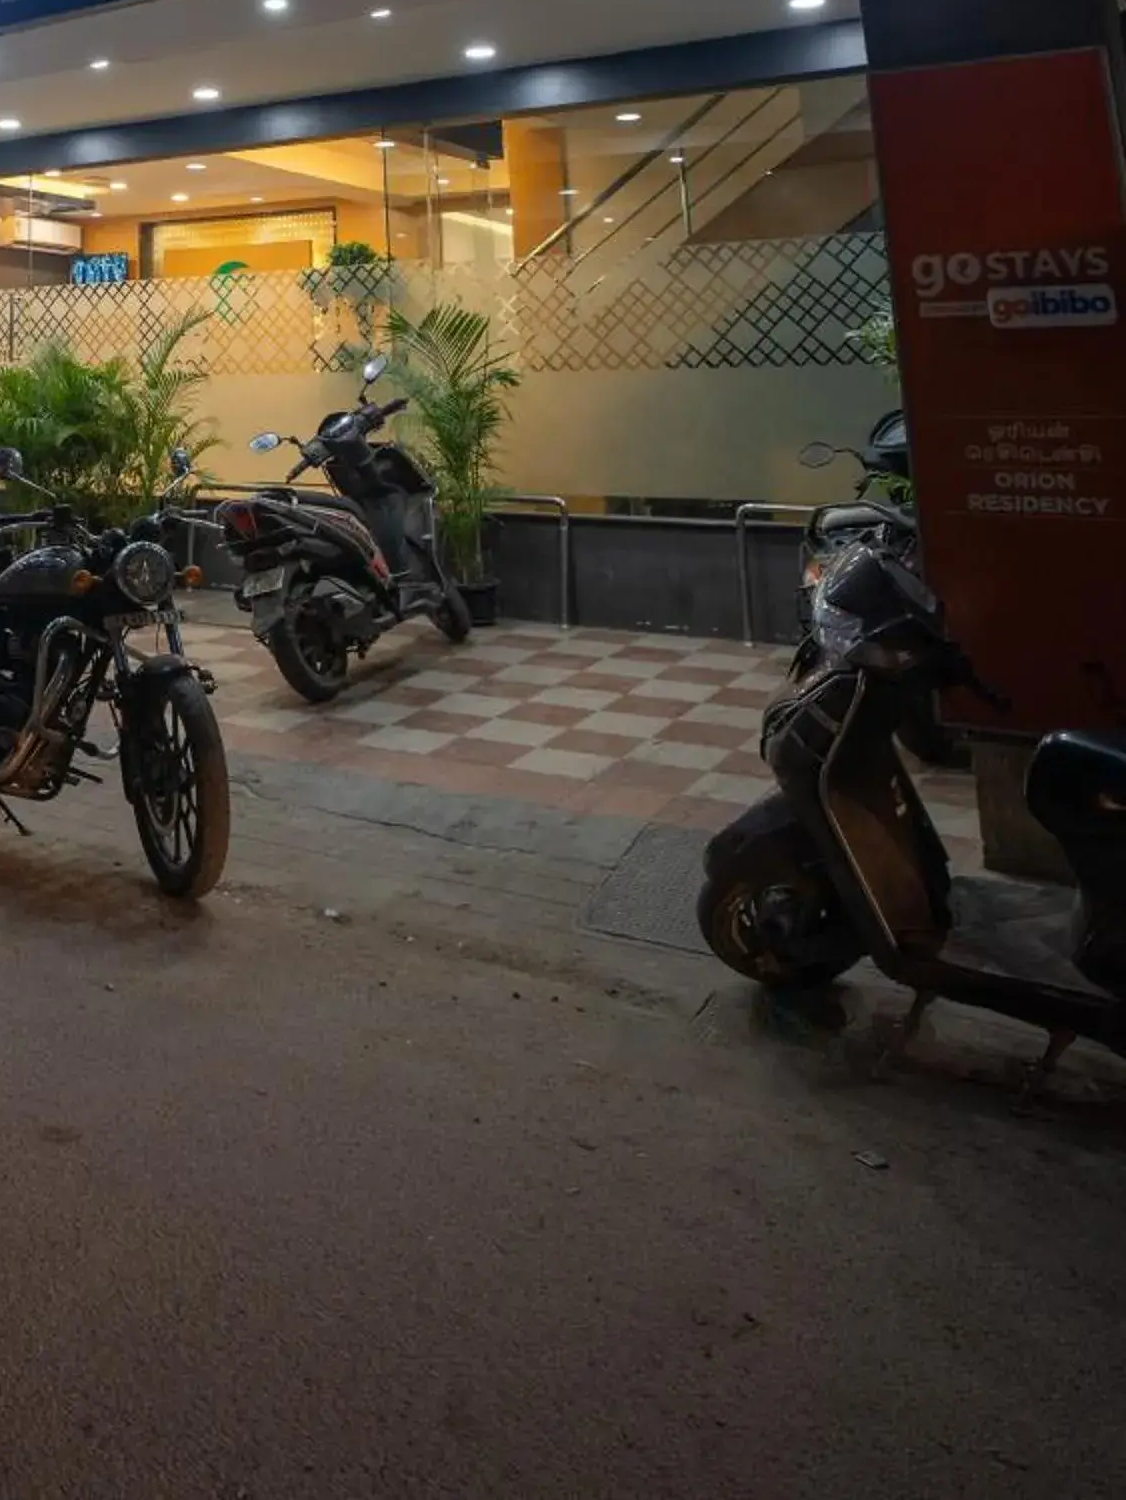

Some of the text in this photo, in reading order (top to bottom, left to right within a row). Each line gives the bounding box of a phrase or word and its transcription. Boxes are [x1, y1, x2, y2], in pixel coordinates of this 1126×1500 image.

[994, 290, 1110, 321] goibibo
[994, 473, 1076, 491] ORION
[967, 493, 1110, 516] RESIDENCY
